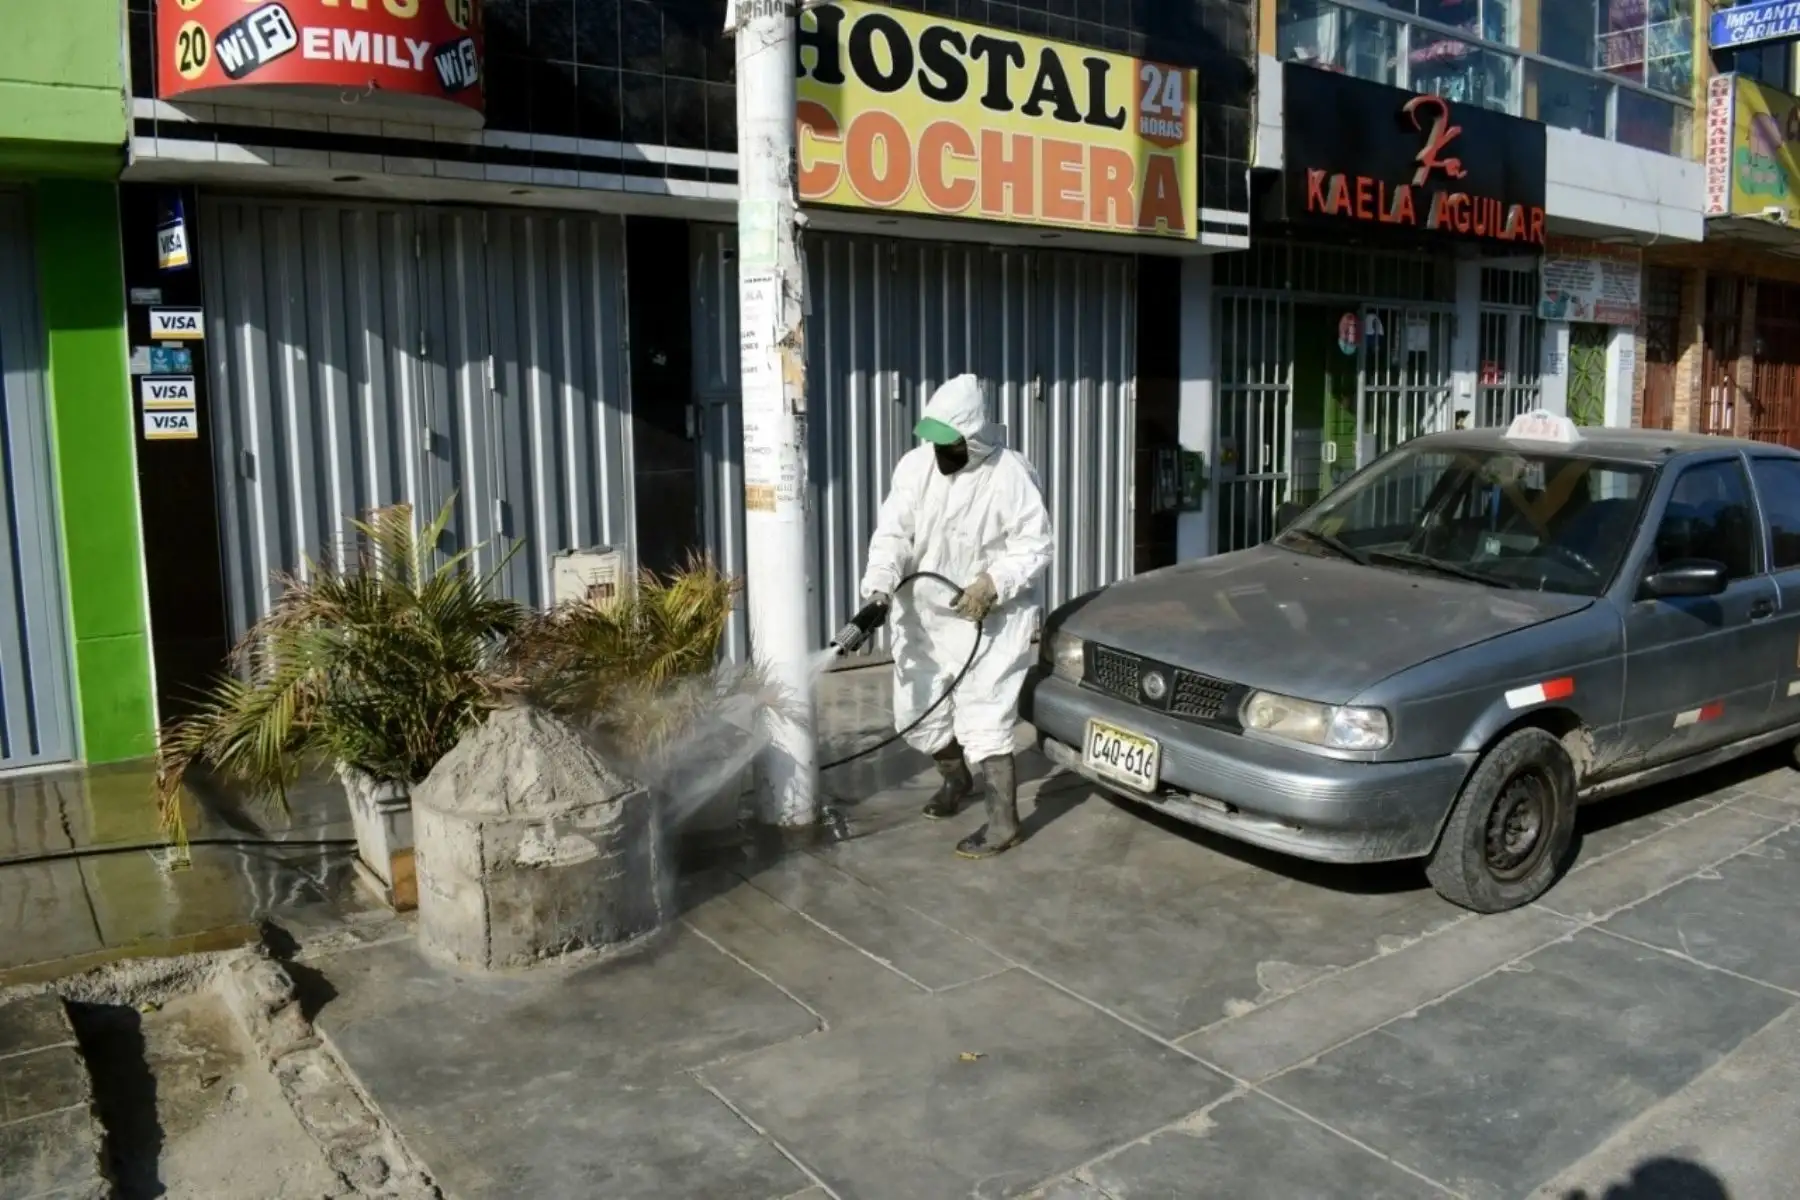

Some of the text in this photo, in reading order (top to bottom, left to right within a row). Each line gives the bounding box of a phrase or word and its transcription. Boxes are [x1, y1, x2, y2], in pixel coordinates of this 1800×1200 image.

[179, 26, 206, 72] 20
[215, 8, 292, 73] WiFi
[303, 26, 431, 71] EMILY
[795, 4, 1126, 131] HOSTAL
[1140, 64, 1184, 116] 24
[1140, 117, 1183, 139] HORAS
[796, 101, 1188, 233] COCHERA
[1307, 167, 1544, 244] KAELA AGUILAR
[160, 233, 183, 251] VISA
[158, 315, 197, 329] VISA
[151, 385, 188, 399] VISA
[152, 415, 189, 429] VISA
